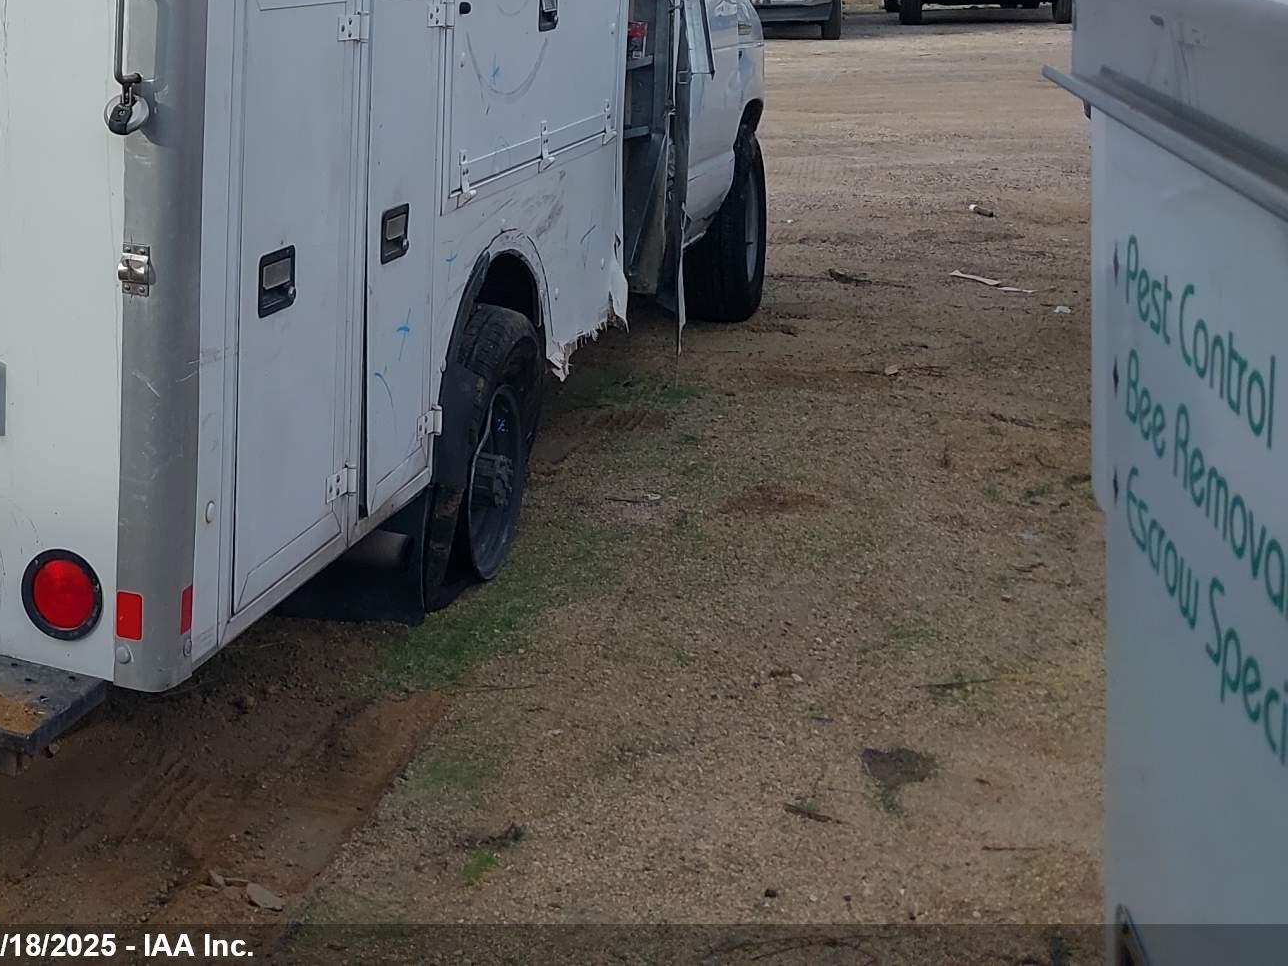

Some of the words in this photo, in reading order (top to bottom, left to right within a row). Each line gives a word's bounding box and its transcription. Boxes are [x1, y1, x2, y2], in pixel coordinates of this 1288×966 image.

[1124, 347, 1167, 460] Bee
[1125, 234, 1173, 346] Pest
[1178, 283, 1277, 450] Control
[1126, 465, 1200, 631] Escrow
